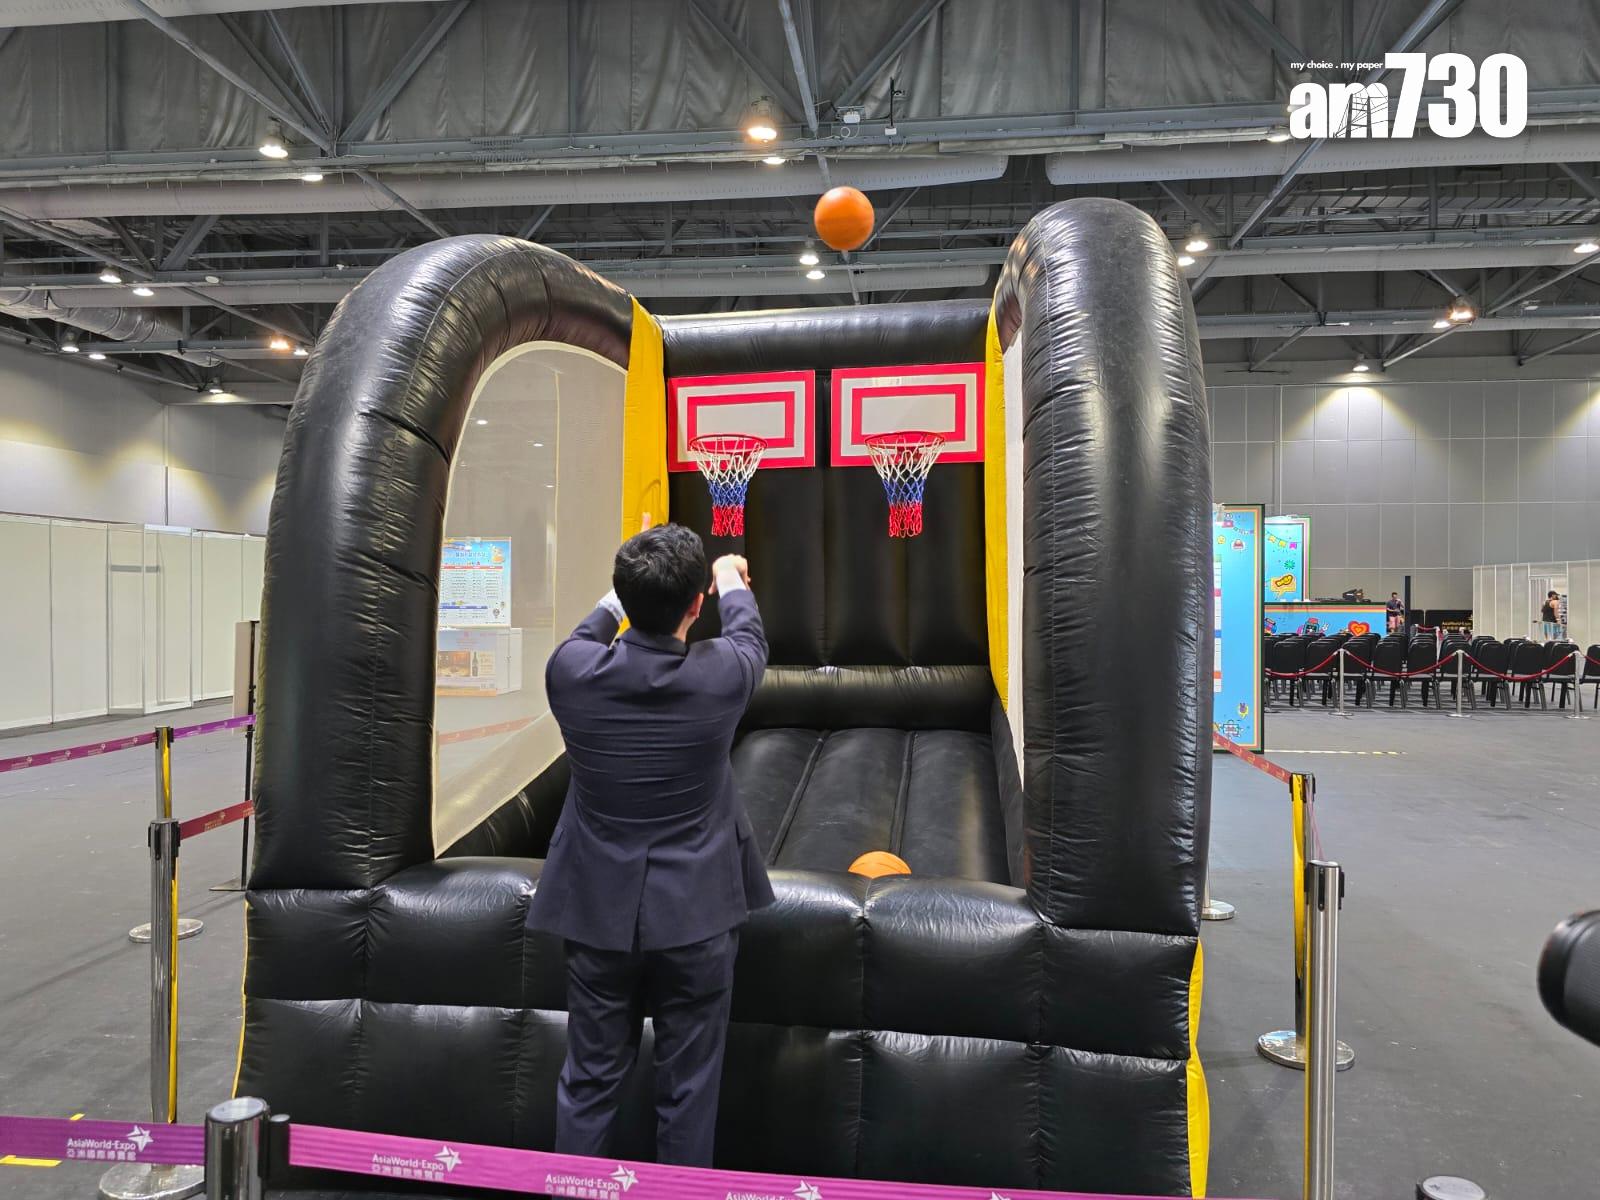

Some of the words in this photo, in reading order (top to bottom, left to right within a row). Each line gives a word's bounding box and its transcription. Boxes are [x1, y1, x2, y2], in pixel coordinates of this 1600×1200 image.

[66, 1138, 137, 1152] AsiaWorld-Expo
[371, 1153, 445, 1171] AsiaWorld-Expo
[545, 1173, 620, 1191] AsiaWorld-Expo
